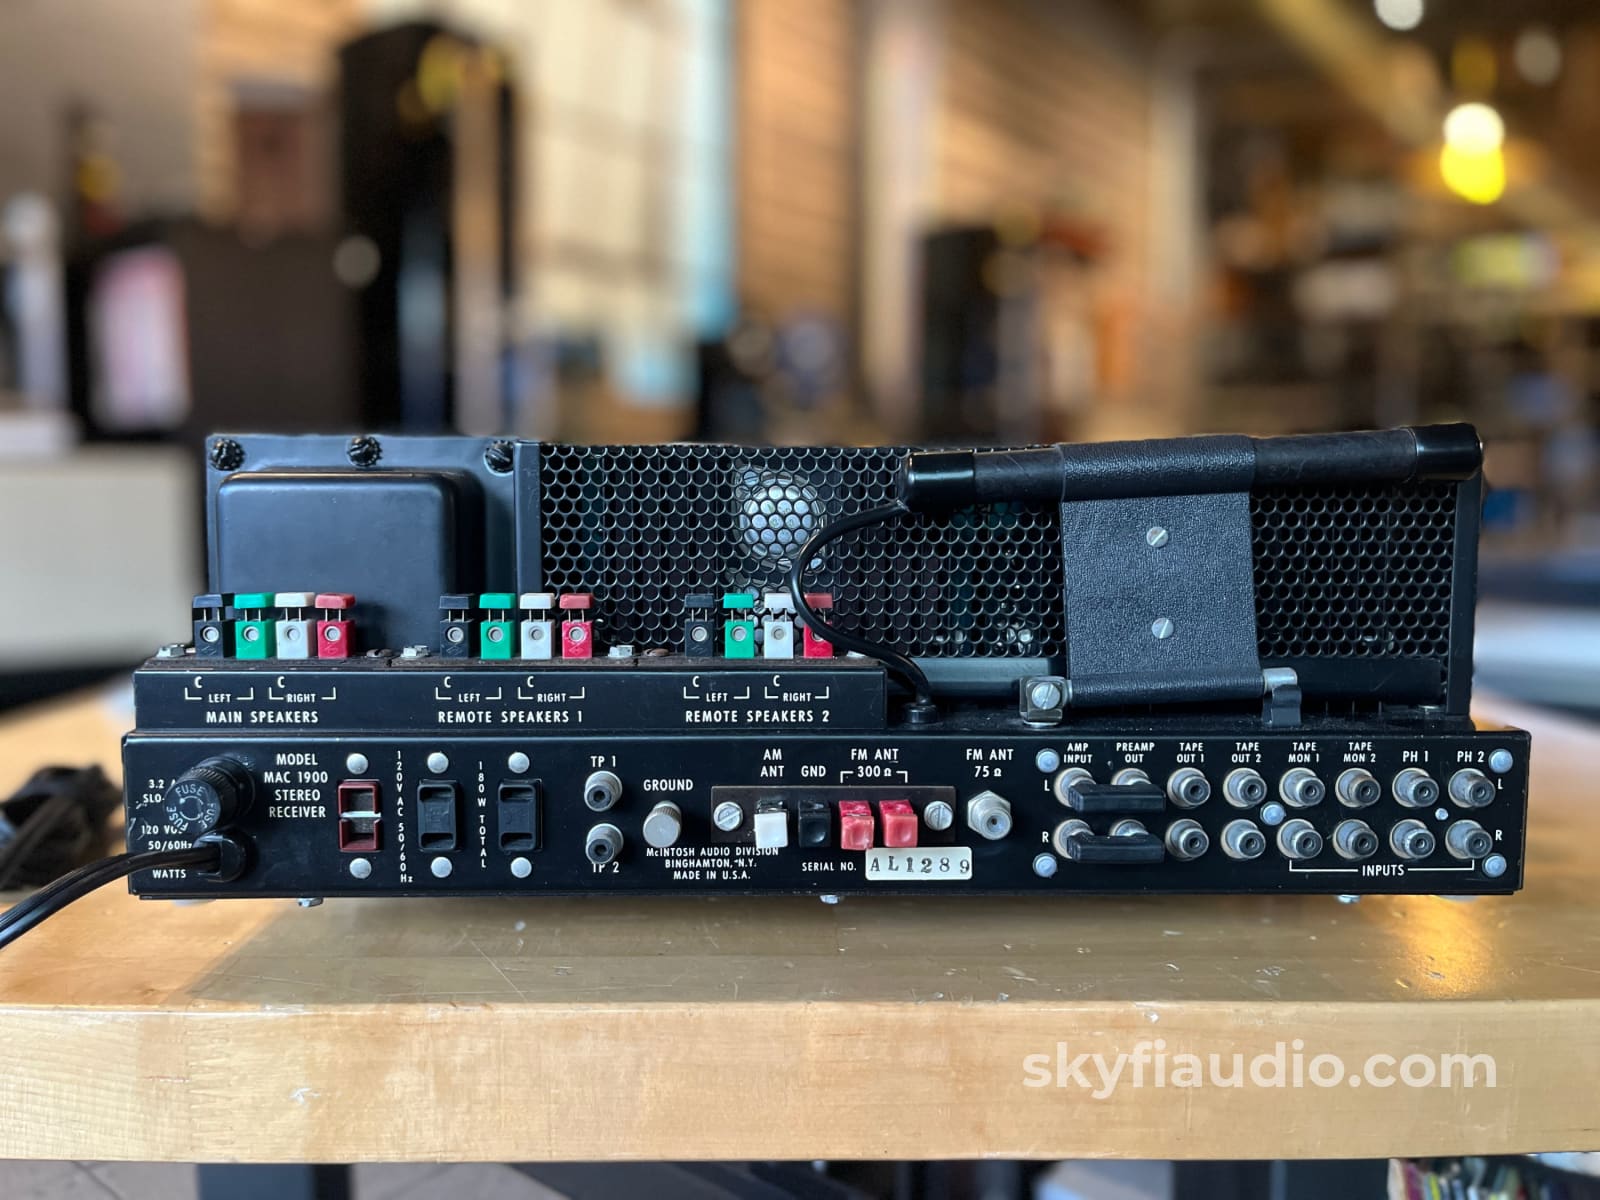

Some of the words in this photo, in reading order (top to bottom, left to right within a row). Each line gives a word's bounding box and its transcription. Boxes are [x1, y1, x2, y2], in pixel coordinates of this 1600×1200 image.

[193, 675, 203, 689] C
[276, 675, 286, 689] C
[443, 675, 452, 689] C
[526, 675, 535, 688] C
[692, 675, 700, 688] C
[772, 674, 781, 687] C
[208, 693, 232, 704] LEFT
[285, 693, 316, 703] RIGHT
[458, 692, 481, 703] LEFT
[537, 692, 567, 703] RIGHT
[705, 692, 728, 703] LEFT
[782, 692, 812, 702] RIGHT
[205, 710, 243, 724] MAIN
[250, 710, 319, 724] SPEAKERS
[437, 710, 492, 724] REMOTE
[501, 710, 570, 724] SPEAKERS
[576, 710, 583, 723] 1
[685, 710, 738, 723] REMOTE
[746, 709, 814, 723] SPEAKERS
[822, 709, 830, 723] 2
[1066, 742, 1089, 752] AMP
[1116, 741, 1155, 752] PREAMP
[1179, 742, 1204, 752] TAPE
[1235, 741, 1260, 752] TAPE
[1292, 741, 1317, 752] TAPE
[1348, 741, 1372, 752] TAPE
[276, 752, 319, 766] MODEL
[763, 748, 782, 761] AM
[850, 748, 868, 761] FM
[874, 748, 899, 761] ANT
[966, 748, 983, 761] FM
[989, 748, 1014, 761] ANT
[1063, 753, 1093, 764] INPUT
[1124, 753, 1144, 764] OUT
[1176, 753, 1196, 764] OUT
[1199, 753, 1206, 763] 1
[1231, 753, 1251, 764] OUT
[1255, 753, 1262, 763] 2
[1287, 753, 1311, 763] MON
[1314, 752, 1321, 763] 1
[1343, 752, 1366, 763] MON
[1369, 752, 1377, 763] 2
[1402, 750, 1419, 763] PH
[1423, 750, 1430, 763] 1
[1456, 750, 1473, 763] PH
[1477, 750, 1485, 763] 2
[590, 755, 605, 768] TP
[610, 755, 617, 768] 1
[263, 770, 291, 784] MAC
[297, 770, 329, 784] 1900
[760, 765, 785, 778] ANT
[800, 765, 827, 778] GND
[857, 764, 881, 778] 300
[974, 765, 990, 778] 75
[148, 778, 165, 789] 3.2
[175, 783, 206, 797] FUSE
[643, 778, 694, 792] GROUND
[1043, 779, 1051, 792] L
[1496, 778, 1504, 790] L
[142, 793, 165, 804] SLO-
[274, 788, 321, 802] STEREO
[269, 805, 327, 818] RECEIVER
[166, 806, 189, 832] FUSE
[141, 823, 160, 836] 120
[1495, 829, 1503, 841] R
[478, 814, 488, 869] TOTAL
[1041, 830, 1049, 843] R
[147, 840, 193, 854] 50/60Hz
[646, 847, 695, 858] McINTOSH
[699, 846, 731, 857] AUDIO
[735, 846, 780, 857] DIVISION
[591, 860, 607, 873] TP
[612, 861, 620, 874] 2
[664, 858, 733, 869] BINGHAMTON,
[801, 861, 835, 872] SERIAL
[840, 861, 857, 872] NO.
[1362, 863, 1405, 877] INPUTS
[152, 868, 187, 879] WATTS
[673, 870, 701, 880] MADE
[706, 870, 717, 880] IN
[722, 869, 751, 880] U.S.A.
